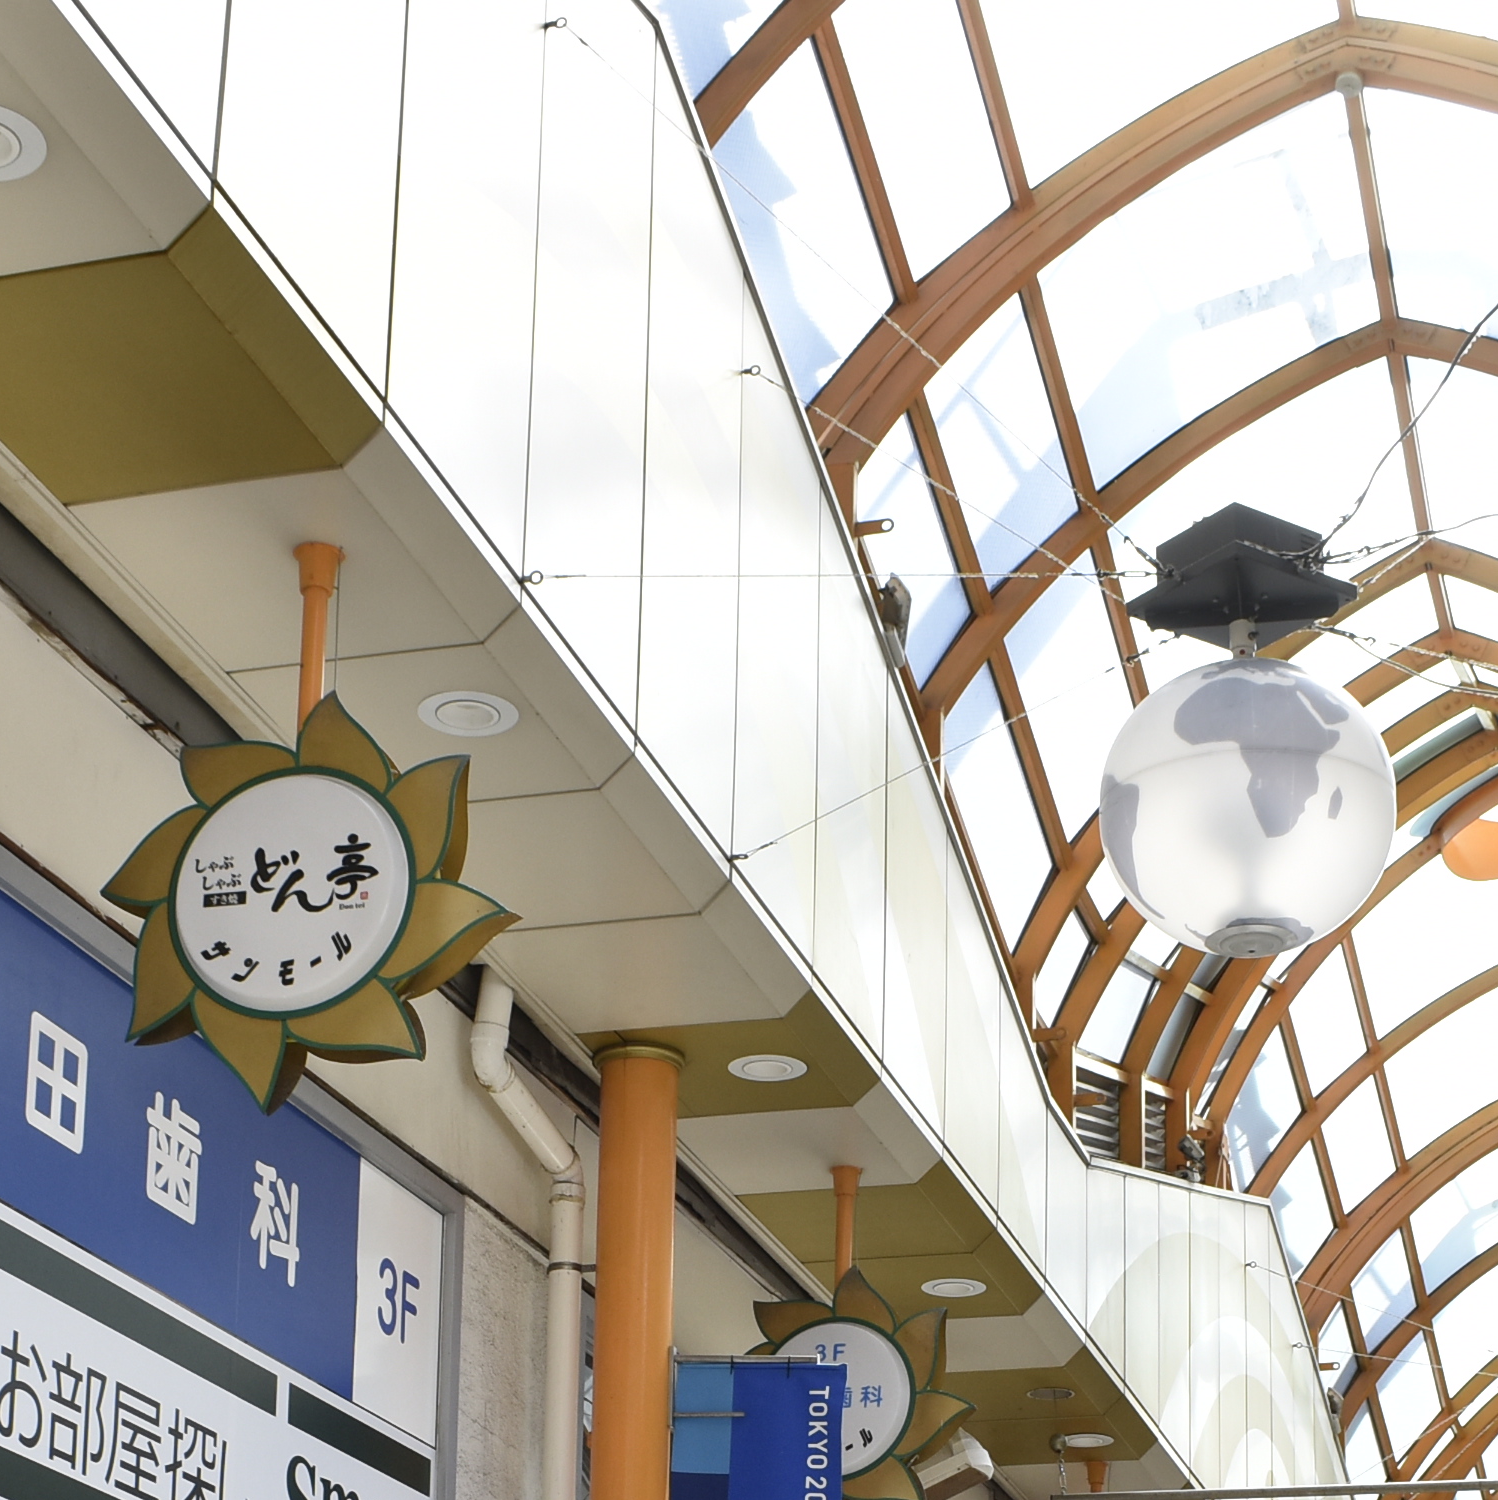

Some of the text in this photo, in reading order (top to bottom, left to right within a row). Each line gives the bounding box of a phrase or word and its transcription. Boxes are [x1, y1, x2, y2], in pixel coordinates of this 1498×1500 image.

[195, 856, 234, 873] しゃぶ
[203, 874, 242, 891] しゃぶ
[251, 833, 379, 913] どん亭
[210, 894, 239, 906] すき焼
[201, 931, 352, 985] サンモール
[377, 1257, 421, 1344] 3F
[807, 1385, 830, 1470] TOKYO
